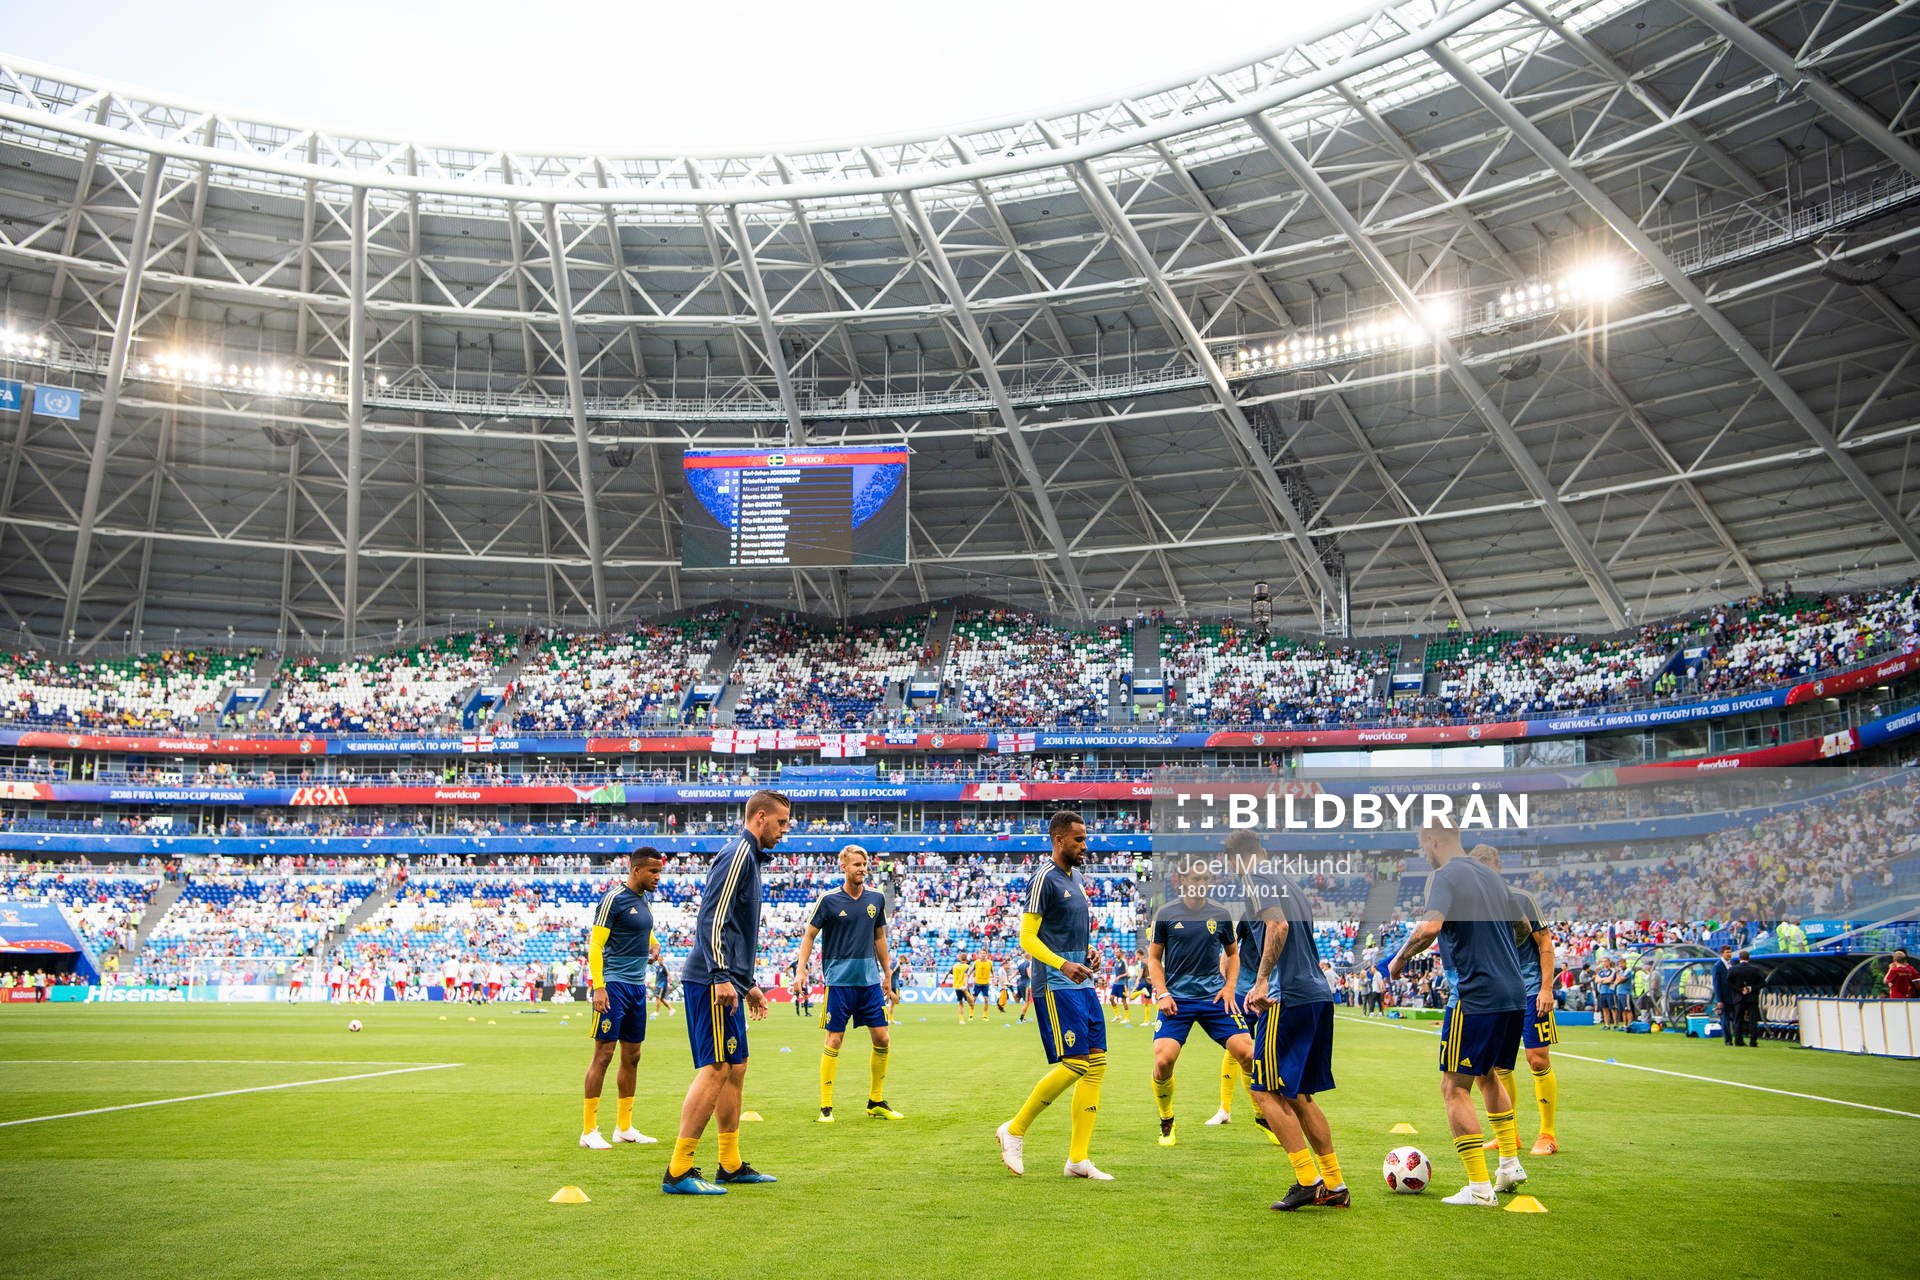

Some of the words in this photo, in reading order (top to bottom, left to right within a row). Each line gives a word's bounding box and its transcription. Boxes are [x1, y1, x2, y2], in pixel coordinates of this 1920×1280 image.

[1549, 716, 1604, 731] ЧЕМПИОНАТ
[1606, 715, 1633, 727] МИРА
[1634, 713, 1648, 724] ПО
[1649, 708, 1691, 722] ФУТБОЛУ
[1691, 706, 1709, 717] FIFA
[1710, 703, 1730, 714] 2018
[1732, 702, 1739, 711] В
[1739, 696, 1773, 710] РОССИИ
[795, 737, 821, 747] МАРА
[1042, 737, 1063, 746] 2018
[1064, 736, 1083, 745] FIFA
[1084, 736, 1117, 745] WORLD
[1117, 736, 1137, 745] CUP
[1140, 735, 1173, 745] RUSSIA
[1357, 731, 1408, 742] #worldcup
[158, 740, 208, 752] #worldcup
[346, 742, 399, 752] ЧЕМПИОНАТ
[400, 741, 424, 751] МИРА
[426, 742, 438, 751] ПО
[440, 741, 462, 751] ФУТБ
[499, 741, 519, 750] 2018
[818, 788, 838, 798] FIFA
[839, 788, 861, 798] 2018
[861, 788, 868, 798] В
[869, 788, 907, 798] РОССИИ
[1131, 786, 1174, 796] SAMARA
[1368, 785, 1390, 794] 2018
[1391, 785, 1411, 793] FIFA
[1411, 783, 1445, 793] WORLD
[1446, 782, 1466, 791] CUP
[109, 790, 132, 800] 2018
[133, 790, 153, 800] FIFA
[154, 791, 188, 801] WORLD
[189, 791, 209, 801] CUP
[210, 791, 245, 801] RUSSIA
[435, 789, 481, 801] #worldcup
[677, 789, 731, 799] ЧЕМПИОНАТ
[733, 789, 757, 798] МИР
[88, 984, 185, 1002] Hisense
[1534, 1021, 1552, 1042] 15
